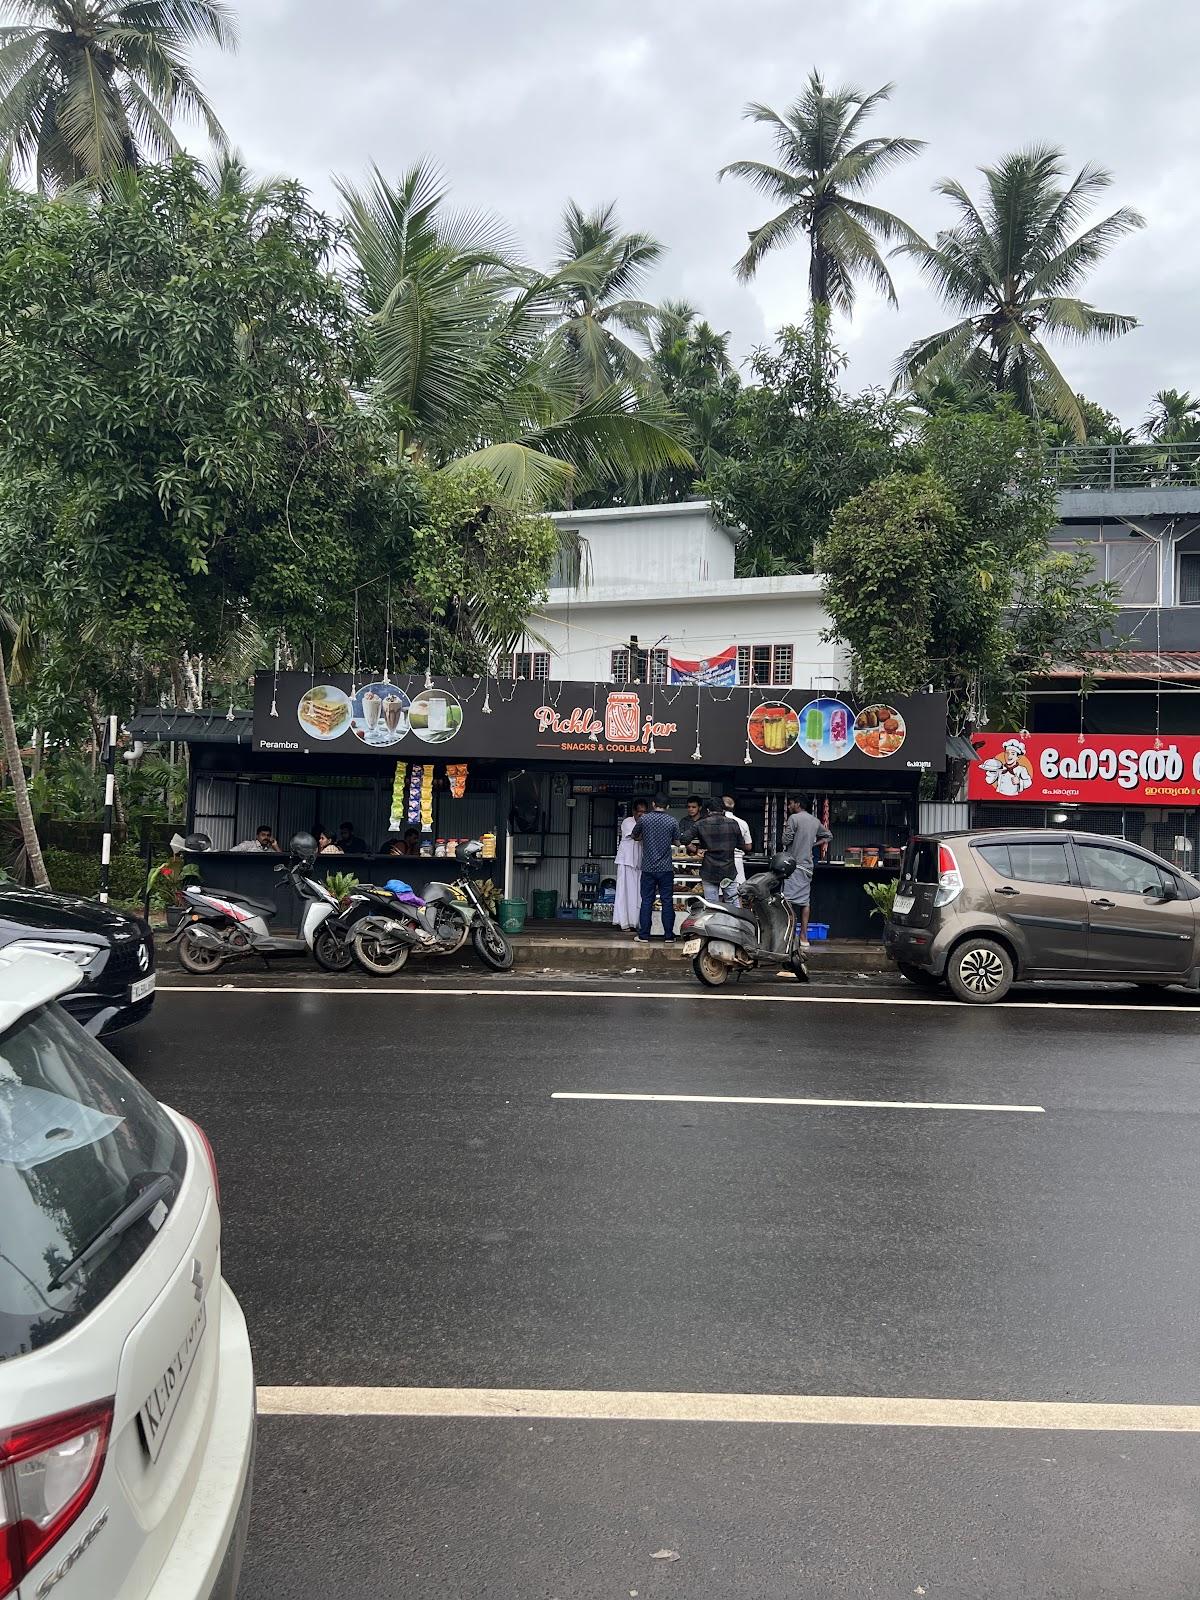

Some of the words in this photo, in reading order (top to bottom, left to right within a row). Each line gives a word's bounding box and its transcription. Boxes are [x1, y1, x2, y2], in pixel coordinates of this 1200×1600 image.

[534, 705, 603, 734] Pickle
[641, 714, 677, 744] jar
[259, 740, 299, 749] Perambra
[560, 742, 596, 751] SNACKS
[597, 743, 605, 751] &
[605, 744, 648, 753] COOLBAR
[1040, 744, 1183, 789] ഹോട്ടൽ
